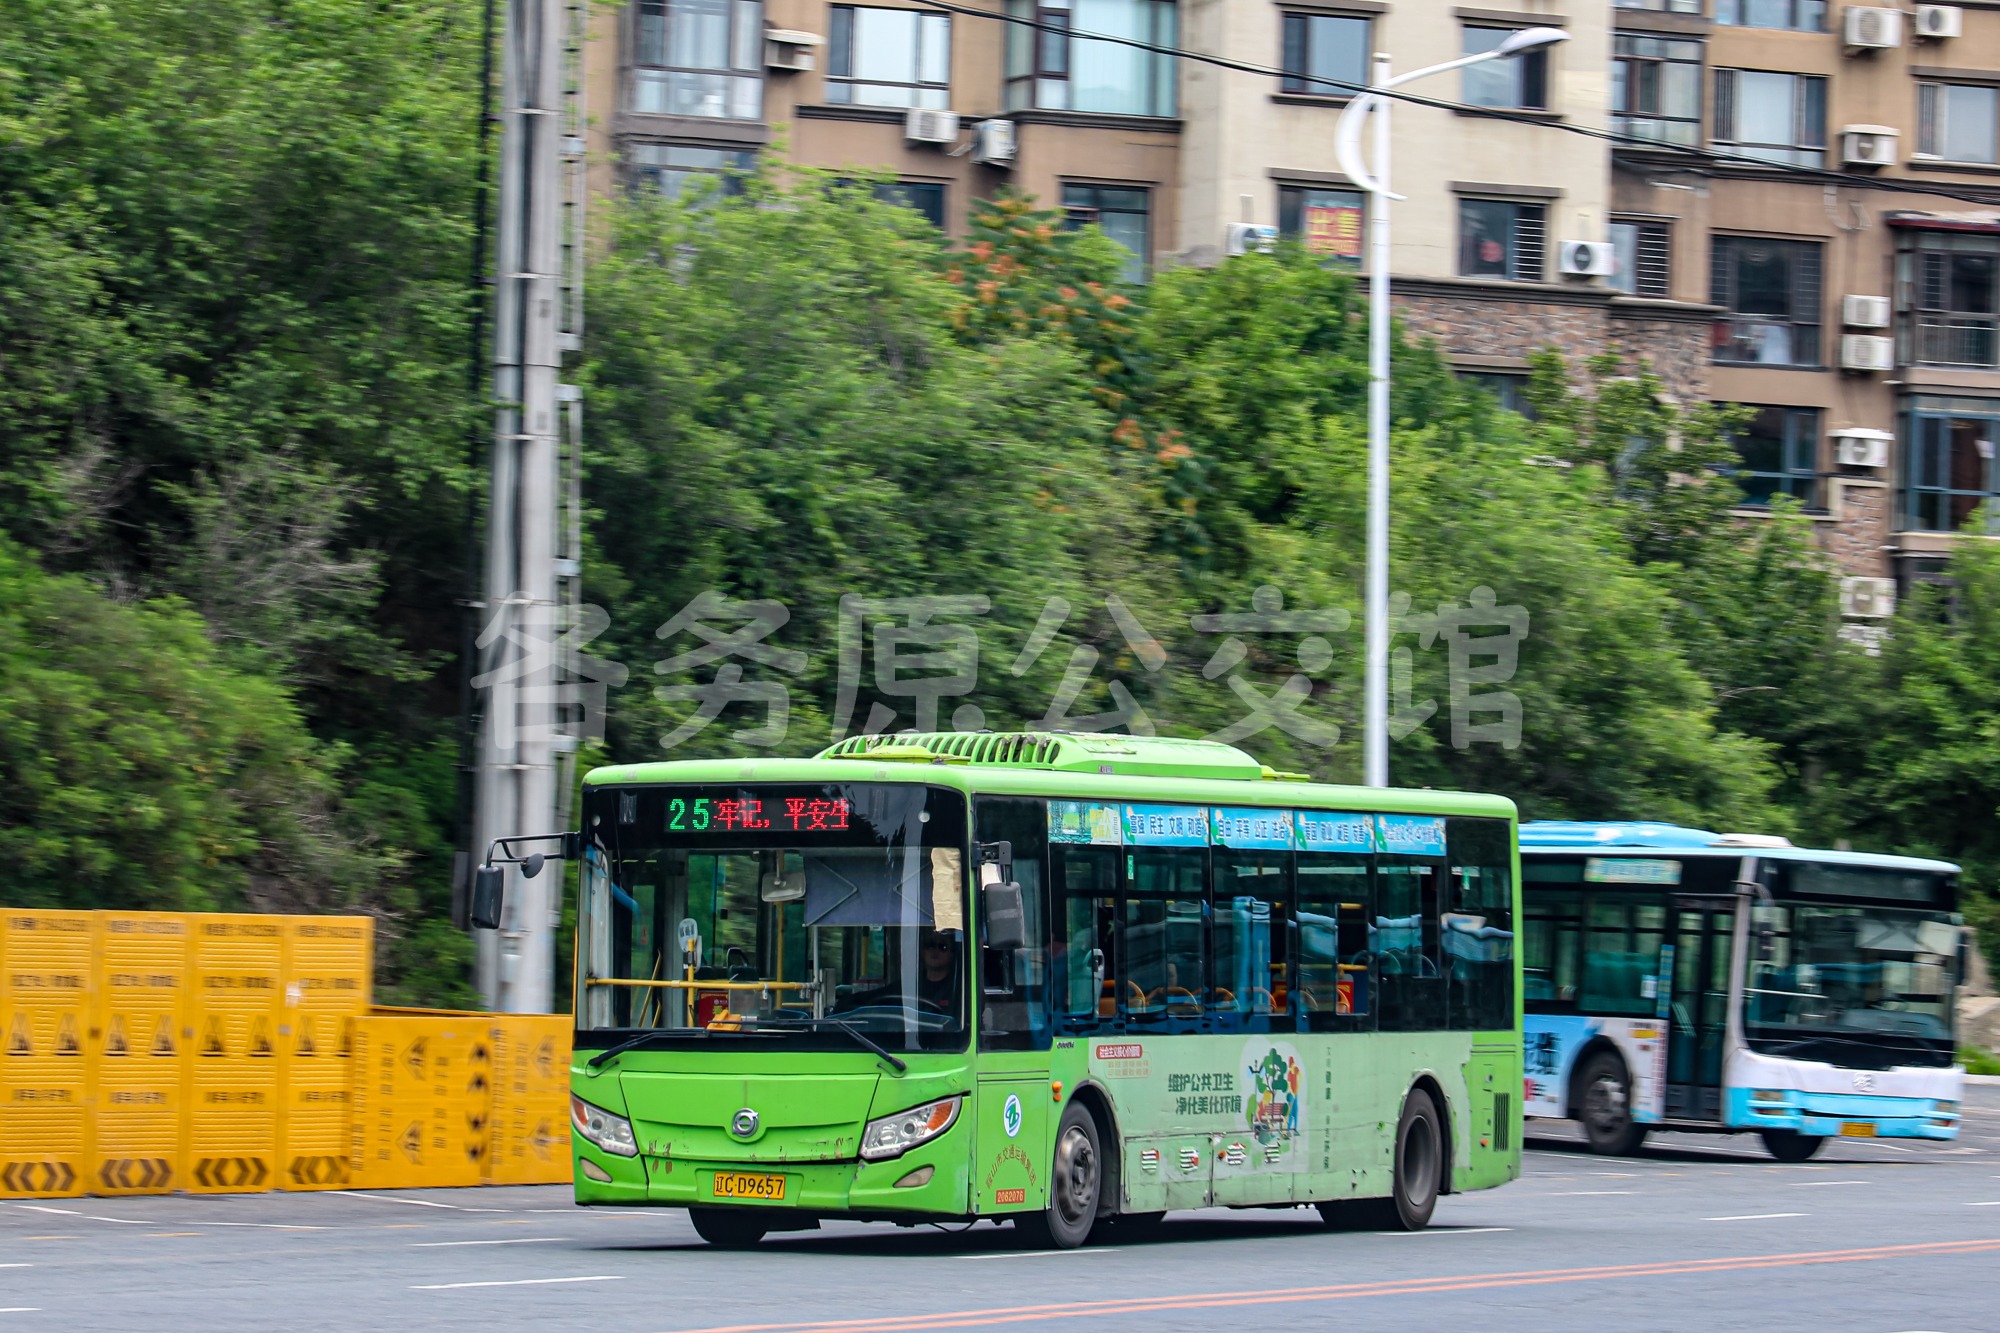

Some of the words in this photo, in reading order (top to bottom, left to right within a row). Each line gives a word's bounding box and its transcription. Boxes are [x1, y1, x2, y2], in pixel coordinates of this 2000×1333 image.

[669, 799, 709, 829] 25
[1150, 815, 1165, 835] 民主
[1168, 1073, 1233, 1092] 维护公共卫生
[1175, 1095, 1242, 1115] 净化美化环境
[997, 1189, 1024, 1204] 2062076
